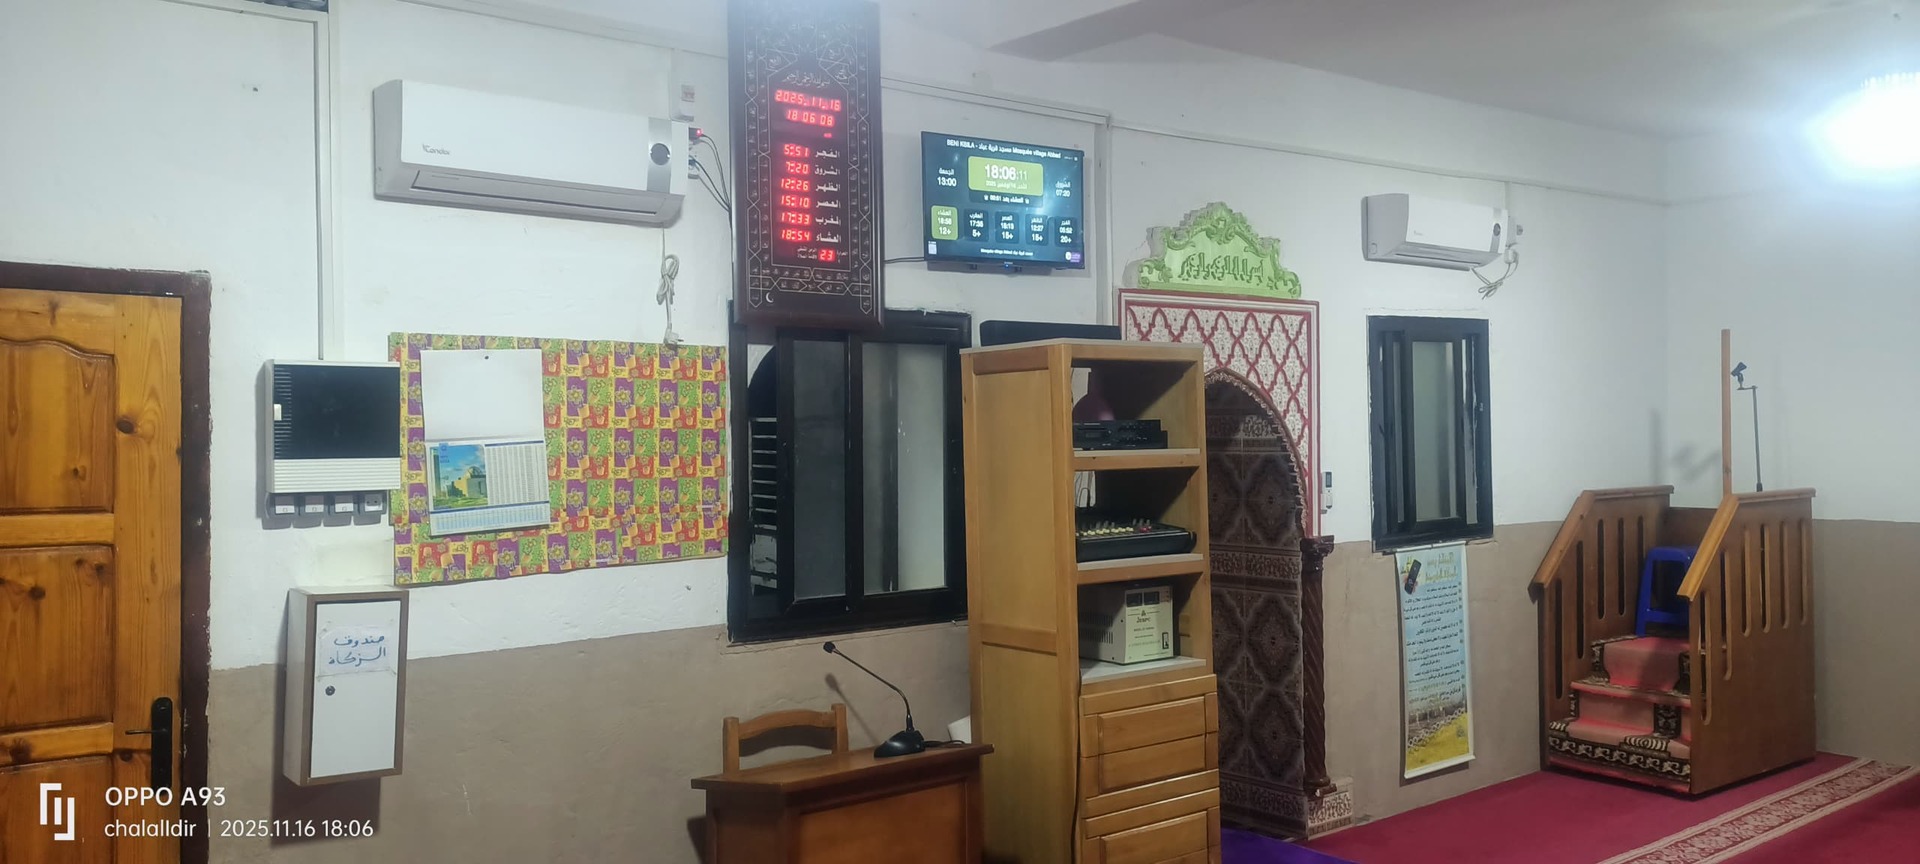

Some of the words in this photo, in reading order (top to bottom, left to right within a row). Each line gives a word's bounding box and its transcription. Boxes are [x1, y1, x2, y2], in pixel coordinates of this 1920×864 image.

[784, 144, 809, 157] 5:51
[815, 149, 840, 158] الفجر
[785, 161, 809, 175] 7:20
[815, 165, 840, 175] الشروق
[781, 178, 809, 191] 12:26
[815, 182, 840, 192] الظهر
[937, 177, 957, 187] 13:00
[781, 195, 809, 208] 15:10
[815, 199, 840, 208] العصر
[781, 212, 810, 224] 17:33
[815, 215, 841, 225] المغرب
[781, 229, 810, 241] 18:54
[816, 232, 841, 243] العشاء
[819, 248, 834, 261] 23
[328, 646, 386, 667] الزكاة
